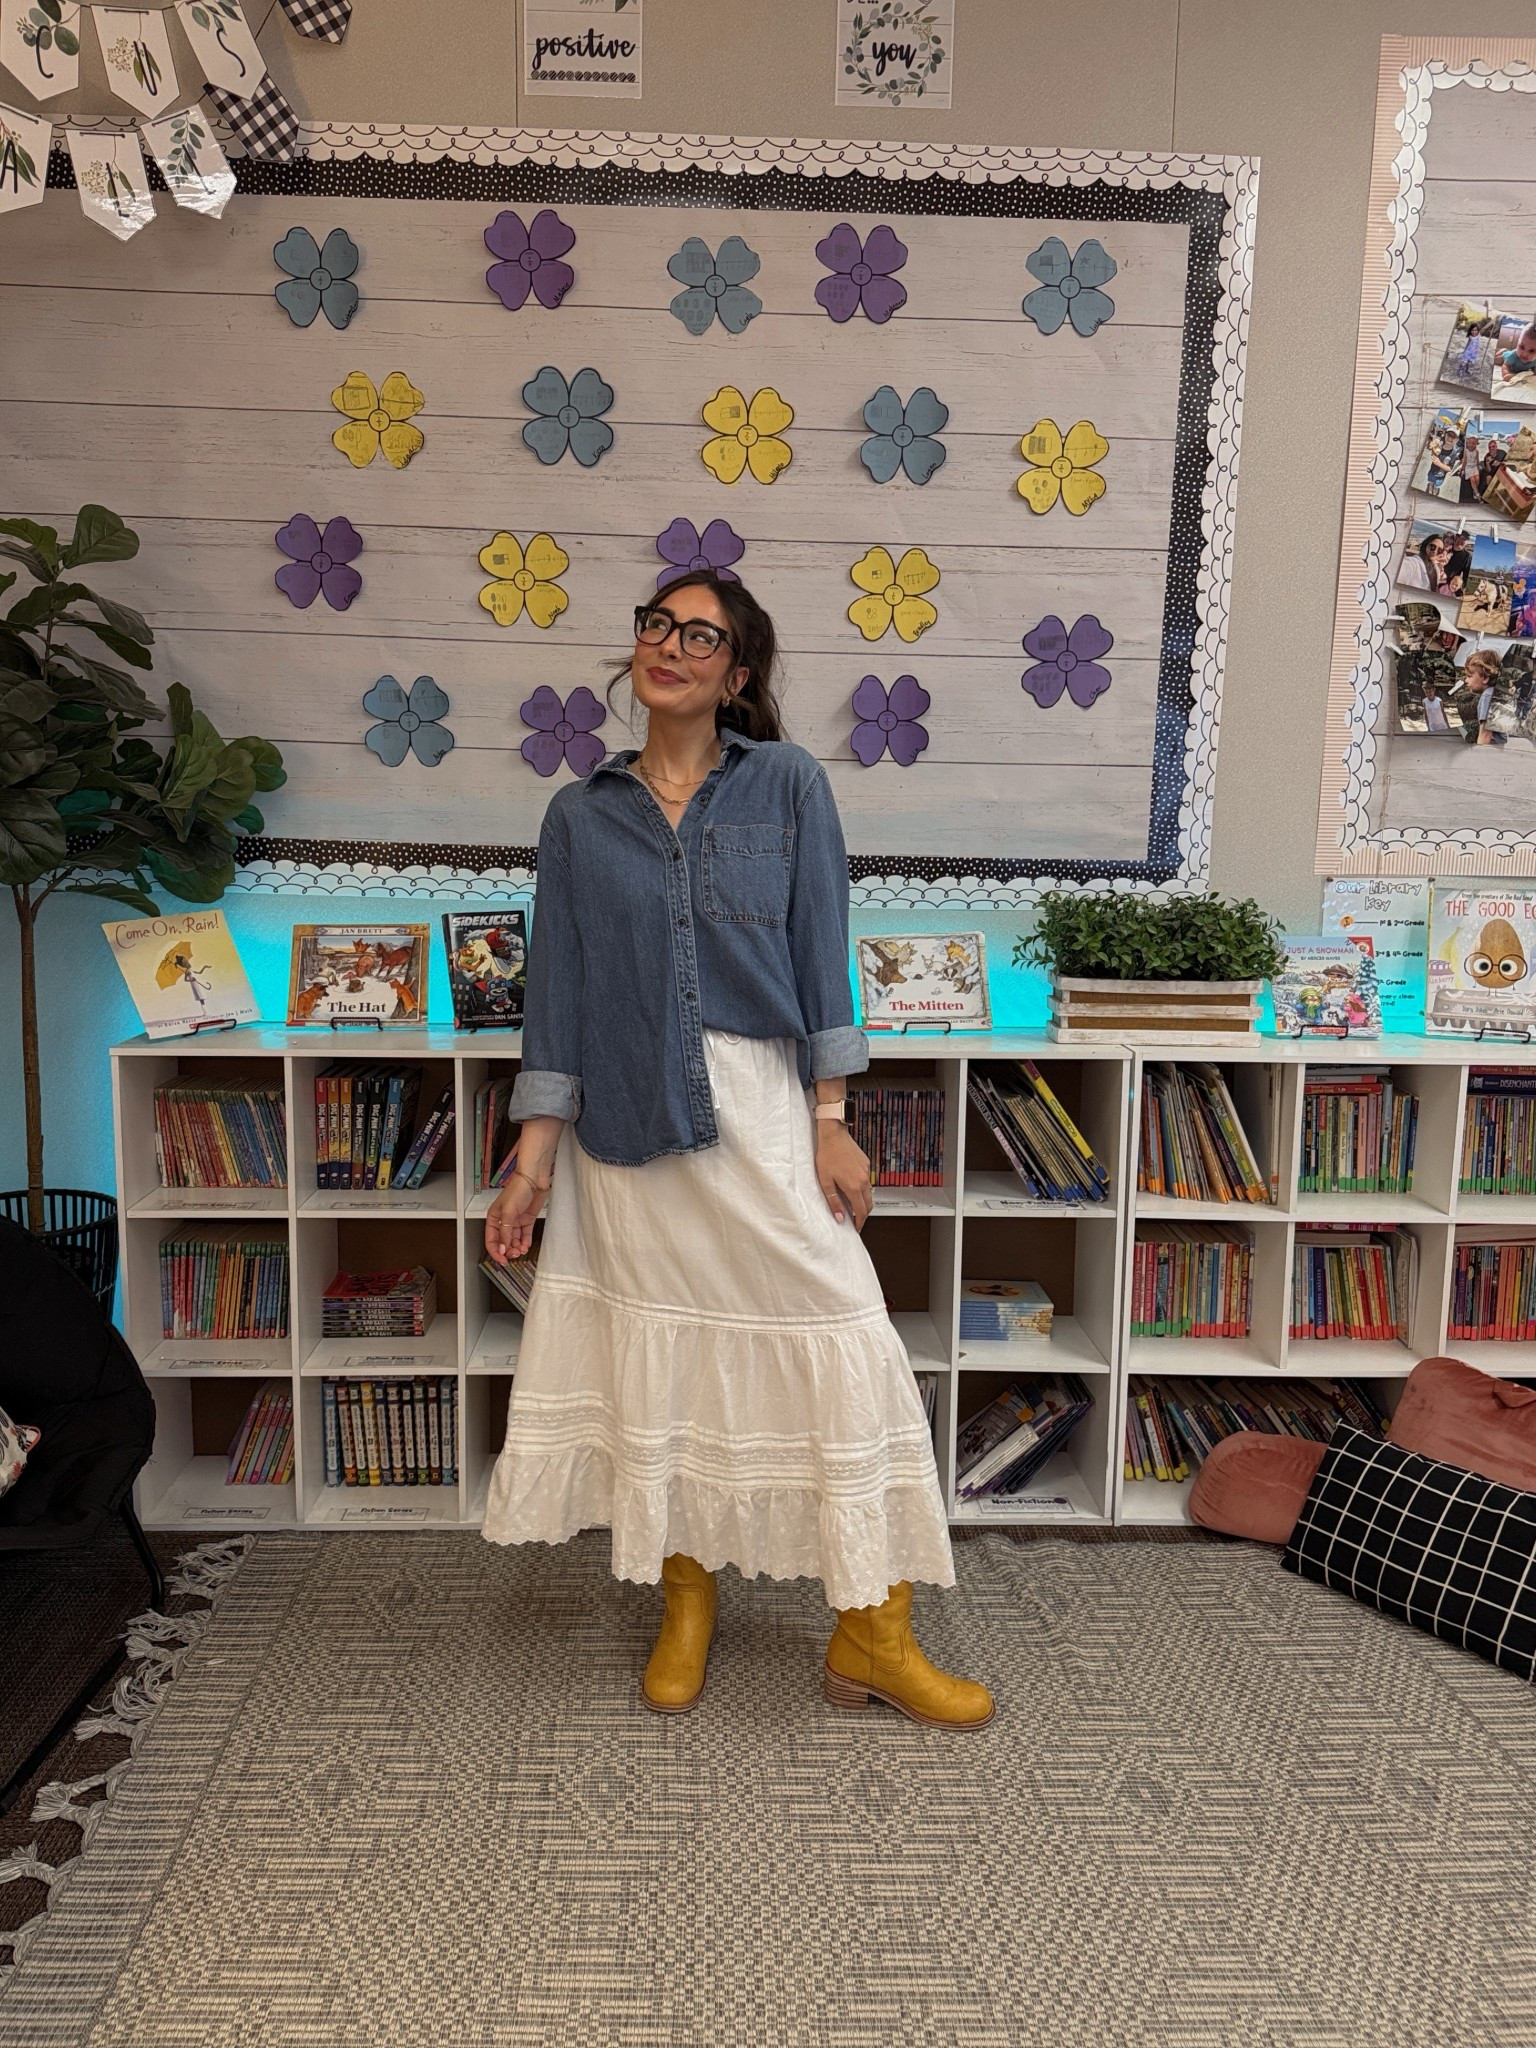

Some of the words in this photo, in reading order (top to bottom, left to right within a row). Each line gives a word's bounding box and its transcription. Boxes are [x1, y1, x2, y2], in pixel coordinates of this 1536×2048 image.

[531, 27, 636, 71] positive
[871, 41, 917, 76] you
[548, 605, 561, 620] Noah
[913, 621, 931, 637] Bradley
[1335, 880, 1365, 893] Our
[1369, 880, 1422, 896] Library
[1364, 896, 1391, 912] Key
[1445, 900, 1469, 917] THE
[1478, 901, 1515, 918] GOOD
[1524, 903, 1536, 919] EG
[115, 924, 150, 949] Come
[182, 912, 220, 934] Rain!
[1316, 946, 1354, 954] SNOWMAN
[327, 1001, 356, 1013] The
[359, 1001, 386, 1013] Hat
[889, 1001, 916, 1011] The
[918, 1001, 964, 1011] Mitten
[1500, 1079, 1536, 1089] DISENCHANT
